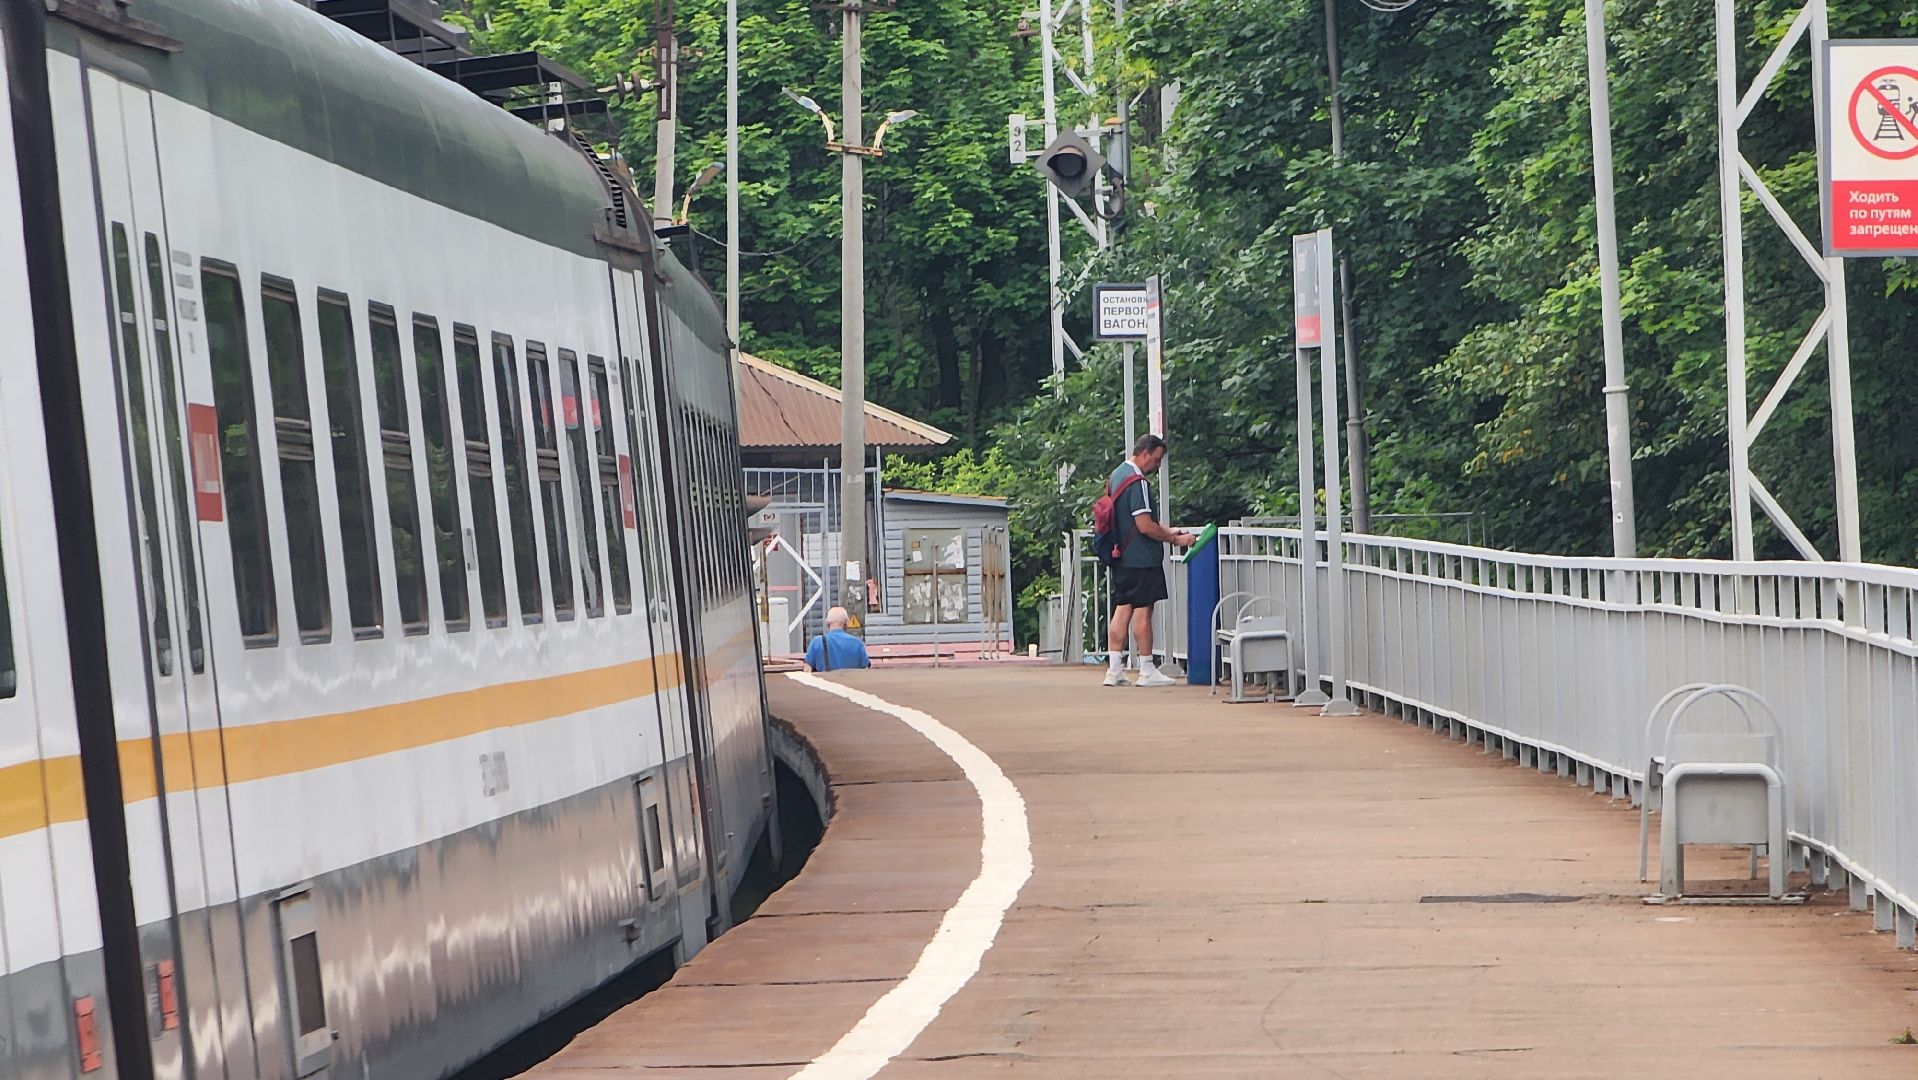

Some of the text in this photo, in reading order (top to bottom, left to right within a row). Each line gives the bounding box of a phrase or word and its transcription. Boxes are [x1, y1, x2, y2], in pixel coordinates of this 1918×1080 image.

[1849, 190, 1900, 205] Ходить
[1849, 208, 1912, 222] по путям
[1849, 224, 1918, 238] запрещен
[1103, 306, 1147, 316] ПЕРВОГ
[1103, 319, 1147, 329] ВАГОН
